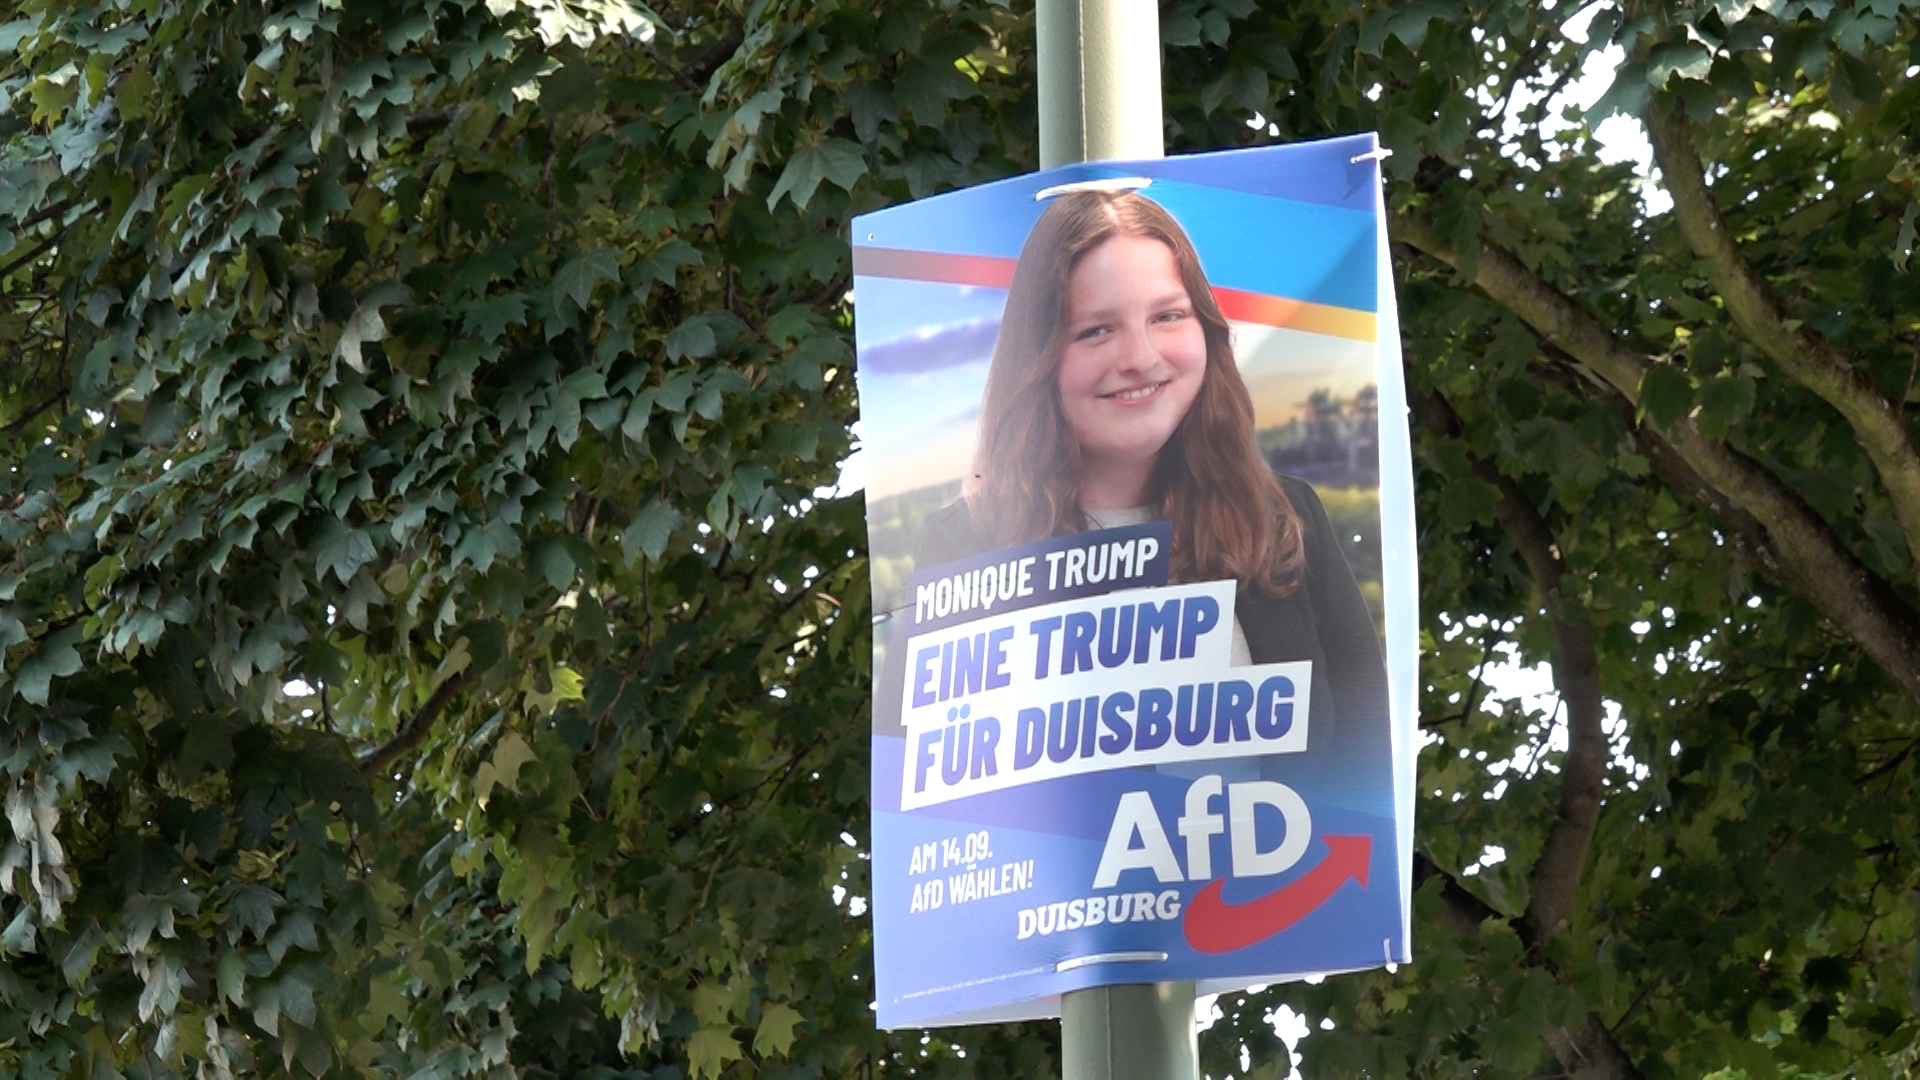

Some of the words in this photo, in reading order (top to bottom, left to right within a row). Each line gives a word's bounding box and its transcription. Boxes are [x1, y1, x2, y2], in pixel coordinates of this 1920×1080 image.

[915, 557, 1036, 623] MONIQUE
[1045, 537, 1160, 591] TRUMP
[911, 626, 1015, 709] EINE
[1030, 595, 1220, 680] TRUMP
[914, 703, 1001, 793] FÜR
[1013, 675, 1295, 771] DUISBURG
[908, 841, 938, 876] AM
[939, 830, 994, 866] 14.09.
[1092, 774, 1312, 889] AfD
[910, 880, 944, 914] AfD
[949, 859, 1035, 904] WÄHLEN!
[1017, 889, 1182, 940] DUISBURG
